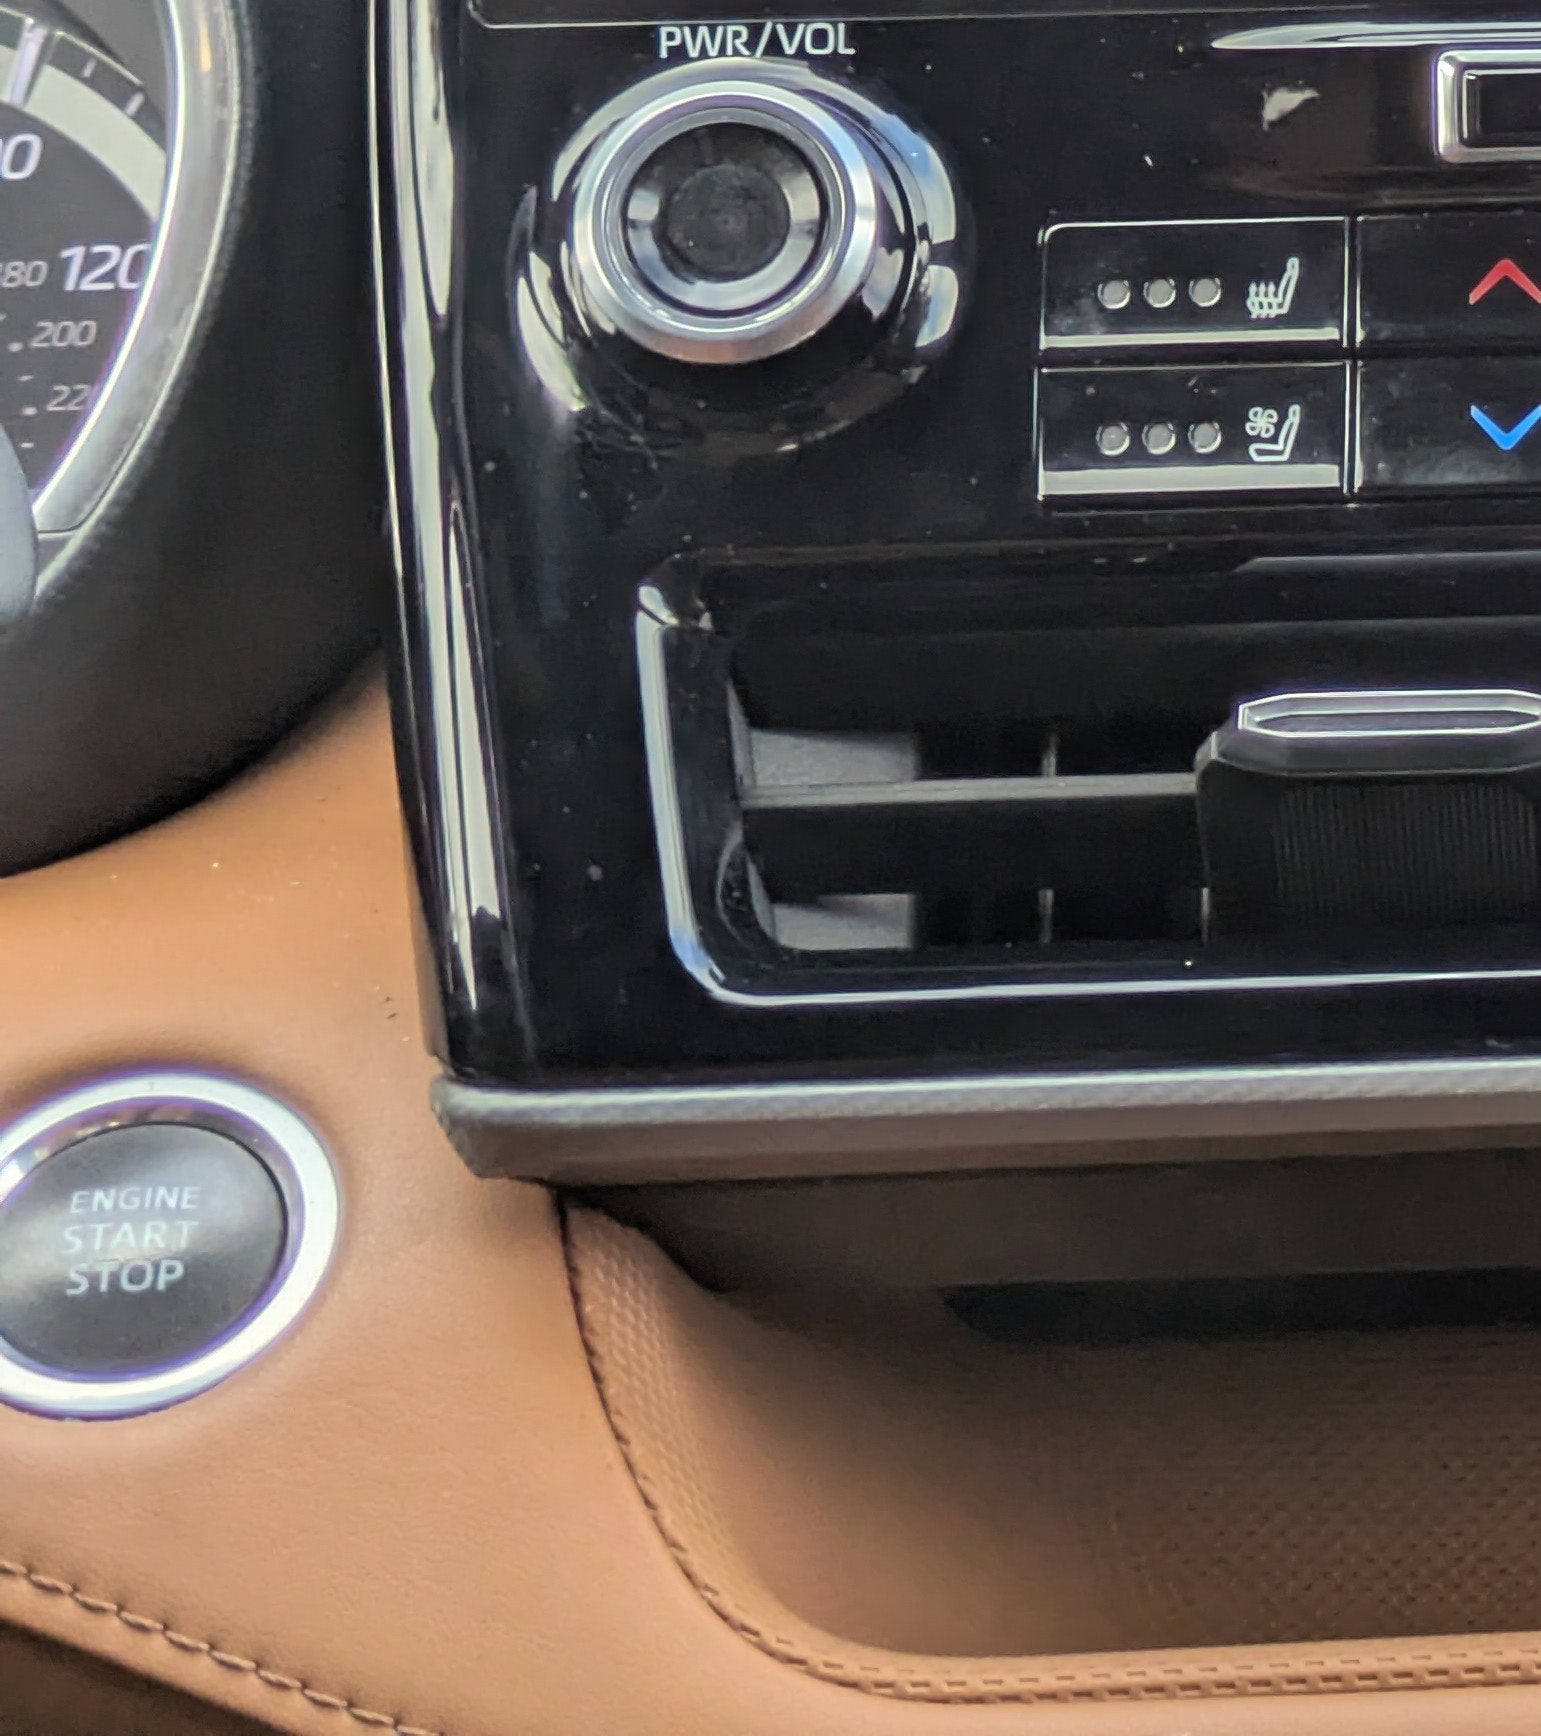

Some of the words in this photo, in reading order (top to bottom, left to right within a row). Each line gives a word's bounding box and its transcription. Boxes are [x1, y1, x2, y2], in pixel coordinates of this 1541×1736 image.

[659, 21, 855, 59] PWR/VOL
[0, 261, 47, 288] 80
[29, 320, 97, 347] 200
[69, 1186, 200, 1214] ENGINE
[61, 1220, 199, 1254] START
[66, 1259, 184, 1296] STOP
